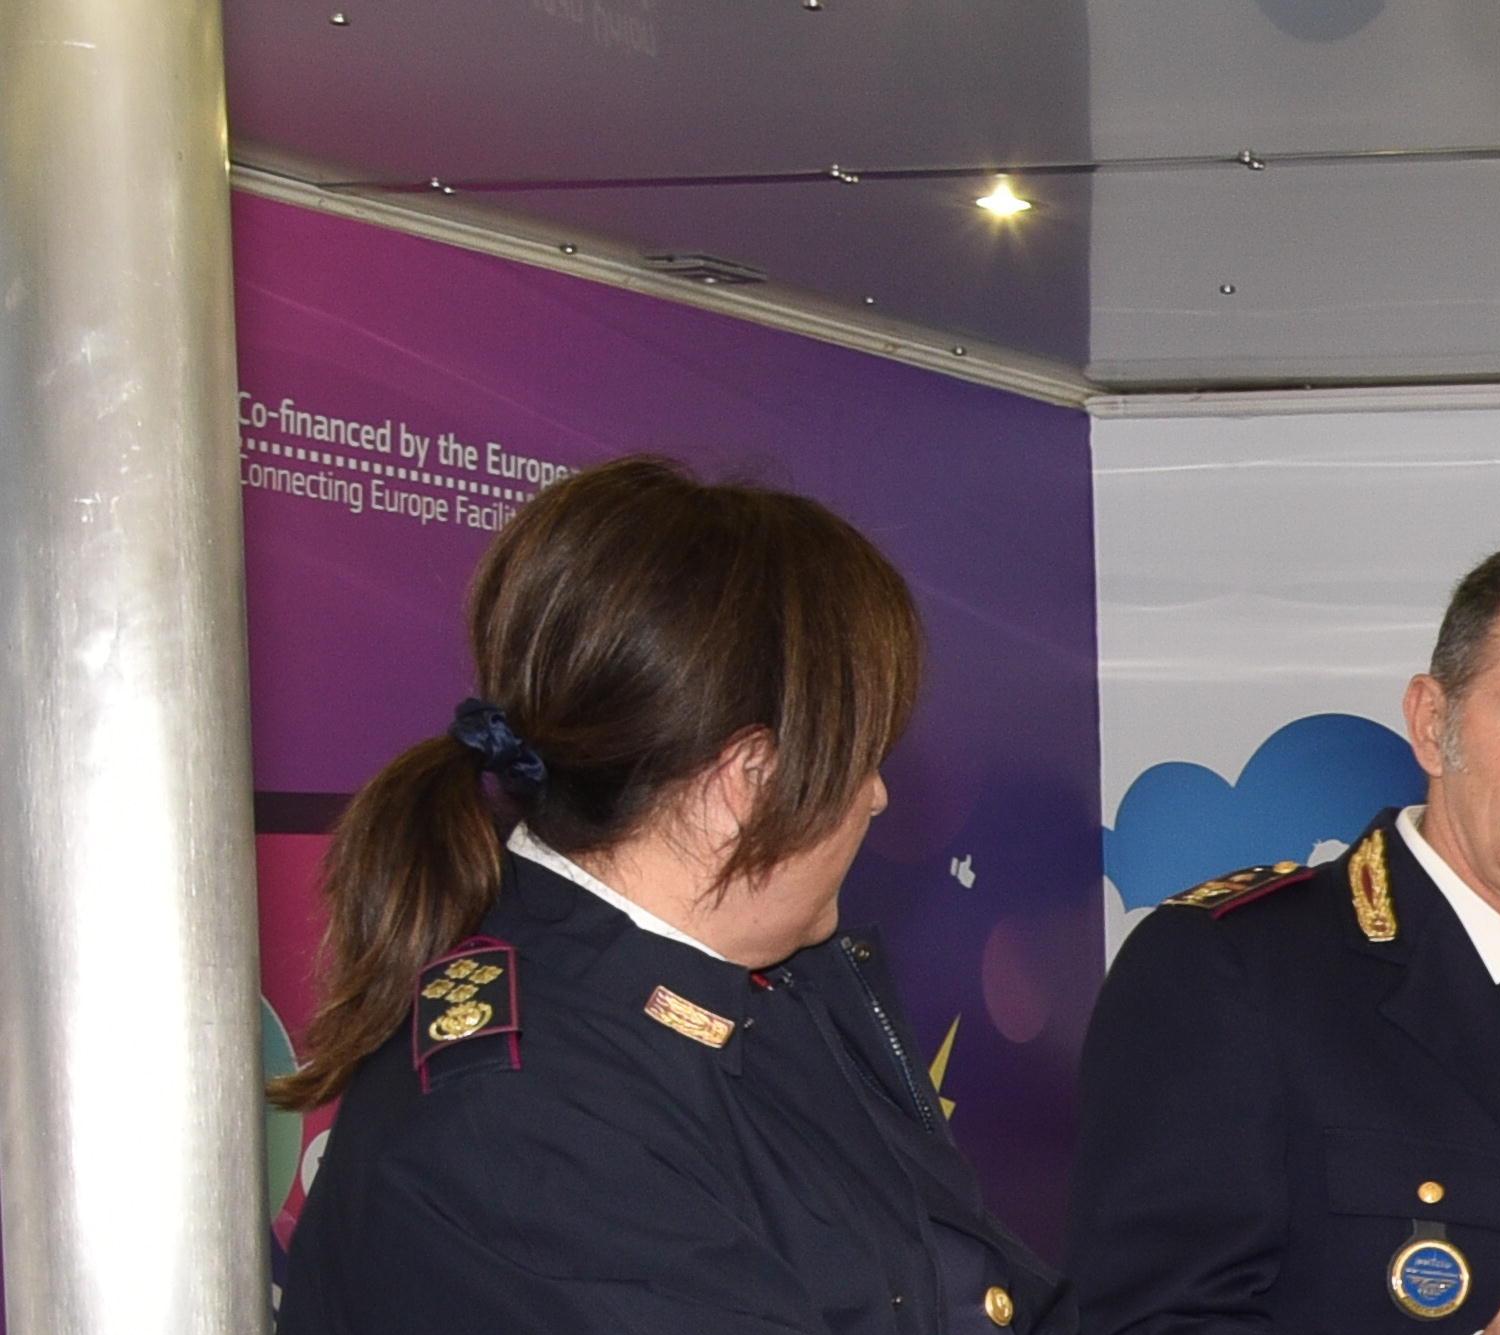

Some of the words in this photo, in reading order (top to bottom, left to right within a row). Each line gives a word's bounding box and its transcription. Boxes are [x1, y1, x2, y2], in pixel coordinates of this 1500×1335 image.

[400, 422, 430, 468] by
[438, 432, 478, 470] the
[371, 480, 448, 525] Europe
[456, 496, 518, 533] Facilit
